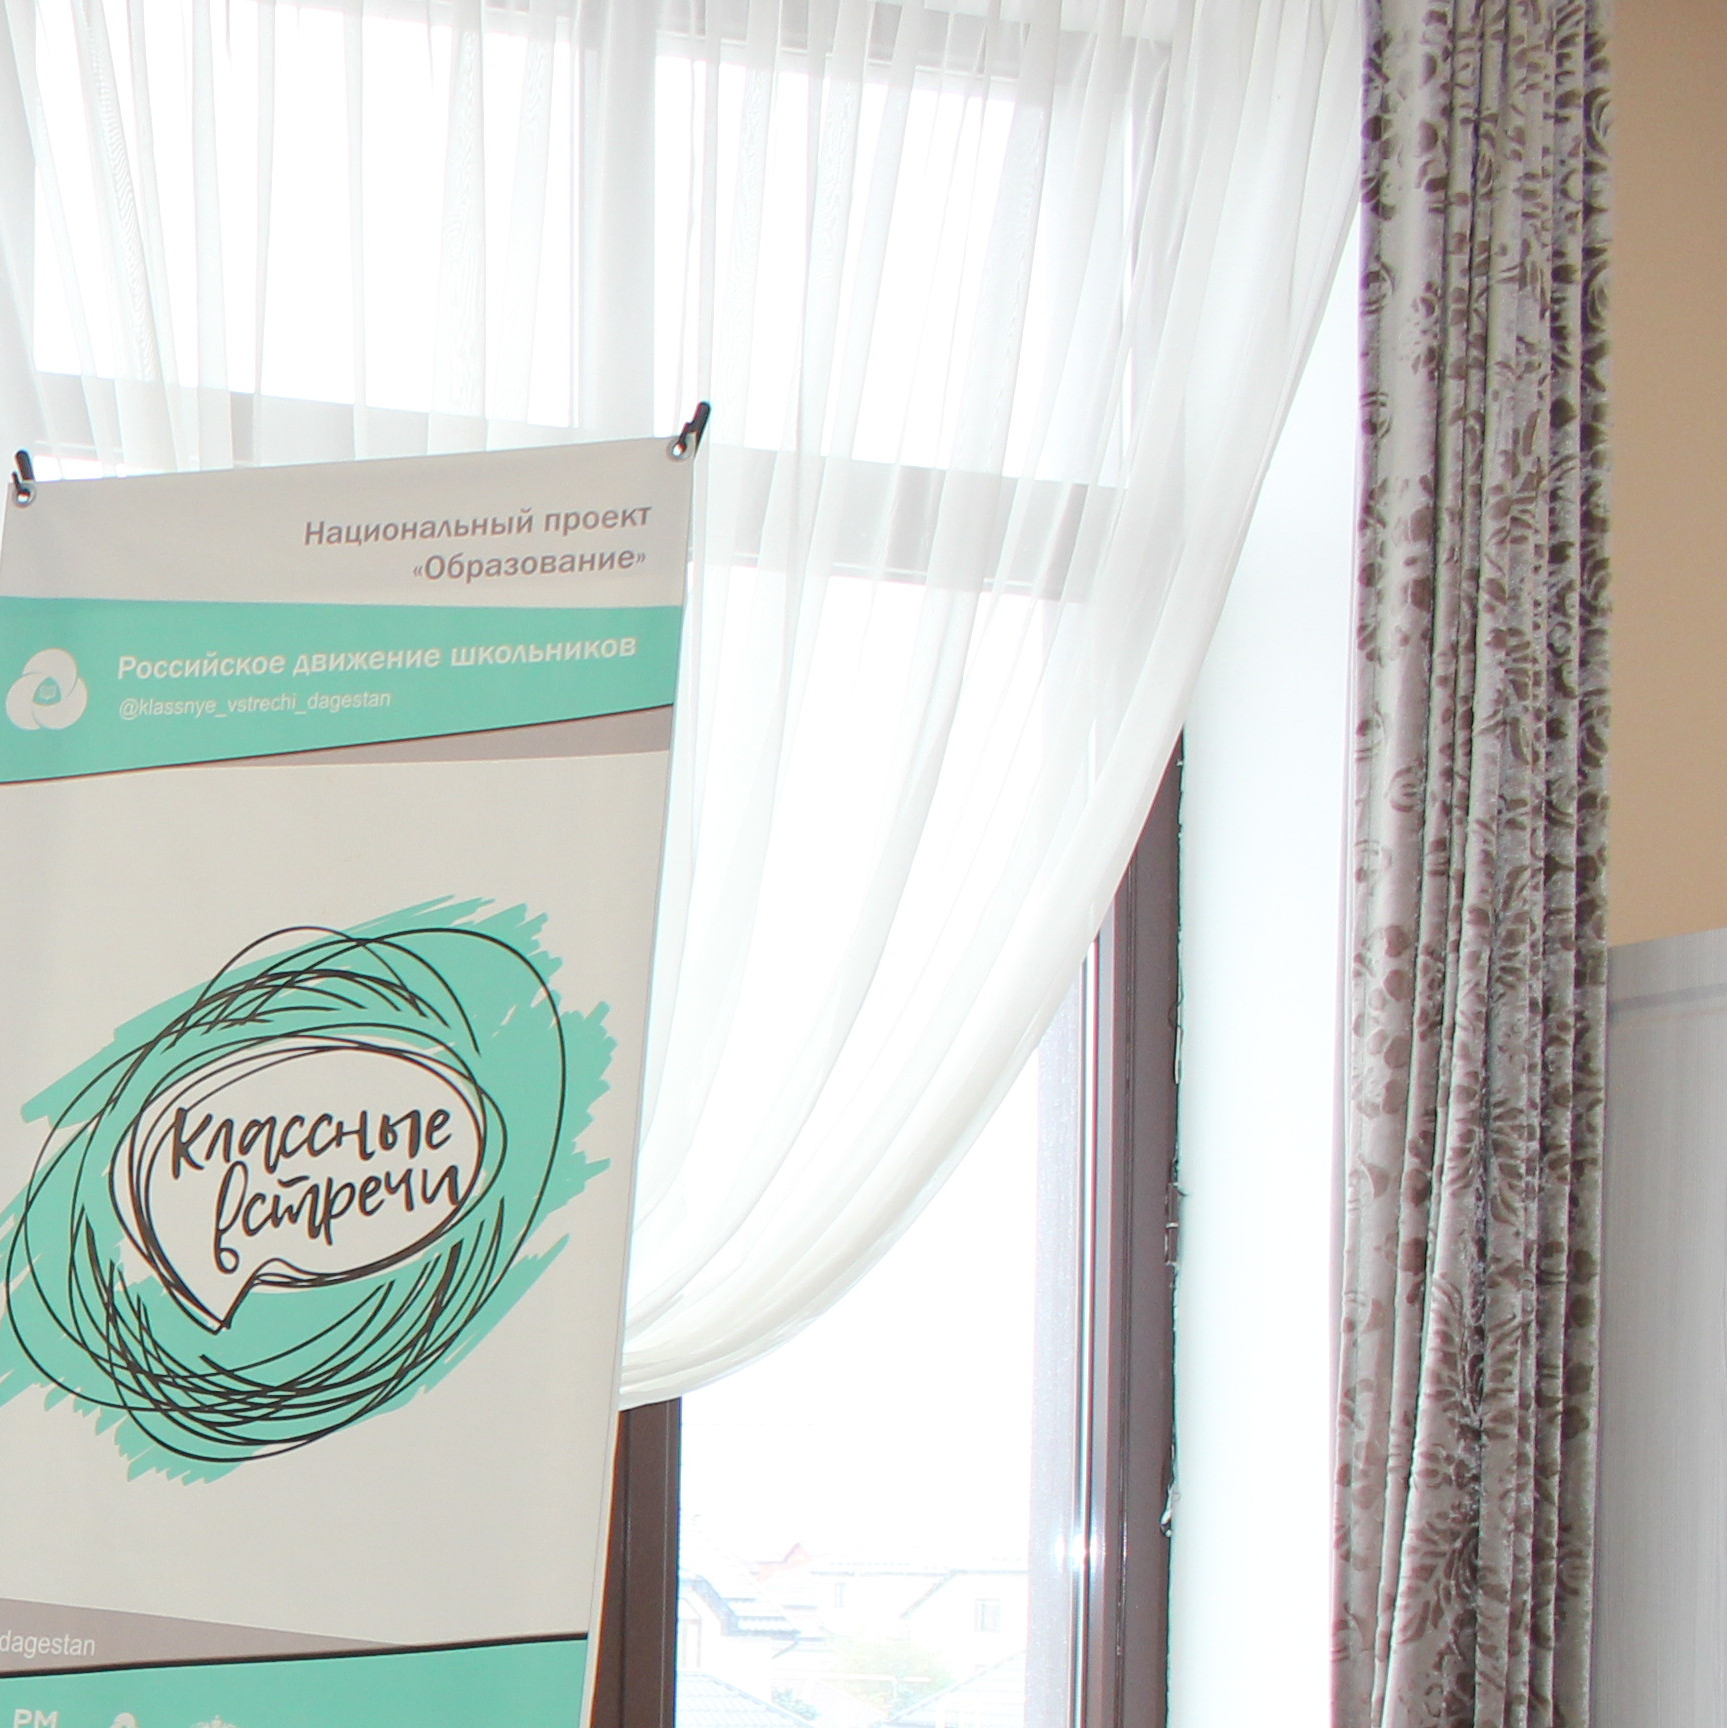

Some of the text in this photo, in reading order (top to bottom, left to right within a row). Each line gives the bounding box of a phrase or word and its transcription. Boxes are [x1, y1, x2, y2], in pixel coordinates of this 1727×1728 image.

[303, 505, 653, 547] Национальный проект
[412, 549, 647, 585] «Образование»
[117, 637, 638, 680] Российское движение школьников
[118, 690, 392, 721] @klassnye_vstrechi_dagestan
